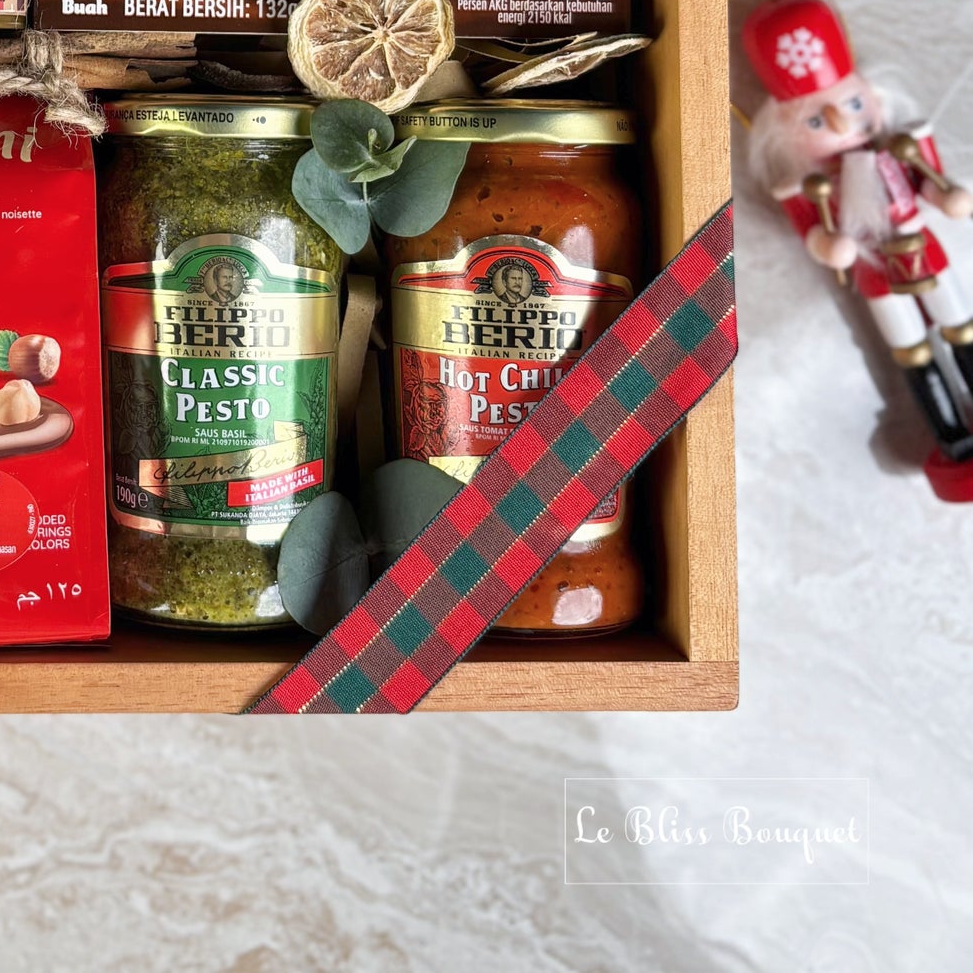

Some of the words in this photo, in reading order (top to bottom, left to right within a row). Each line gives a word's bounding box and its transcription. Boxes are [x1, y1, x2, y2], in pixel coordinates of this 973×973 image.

[489, 0, 507, 11] AKG
[510, 0, 564, 12] berdasarkan
[566, 0, 612, 13] kebutuhan
[498, 11, 525, 26] energi
[528, 11, 551, 23] 2150
[553, 12, 571, 24] kkal
[136, 110, 169, 121] ESTEJA
[172, 110, 234, 123] LEVANTADO
[402, 116, 427, 126] SAFETY
[429, 117, 467, 127] BUTTON
[482, 118, 497, 128] UP
[1, 209, 42, 219] noisette
[164, 306, 284, 323] FILIPPO
[451, 305, 576, 325] FILIPPO
[154, 322, 290, 347] BERIO
[442, 321, 583, 350] BERIO
[170, 347, 221, 357] ITALIAN
[161, 357, 285, 390] CLASSIC
[439, 357, 490, 393] HOT
[176, 392, 271, 423] PESTO
[195, 428, 219, 437] SAUS
[222, 430, 247, 438] BASIL
[481, 426, 507, 435] TOMAT
[250, 475, 282, 491] MADE
[285, 467, 308, 484] WITH
[244, 486, 288, 502] ITALIAN
[289, 474, 315, 491] BASIL
